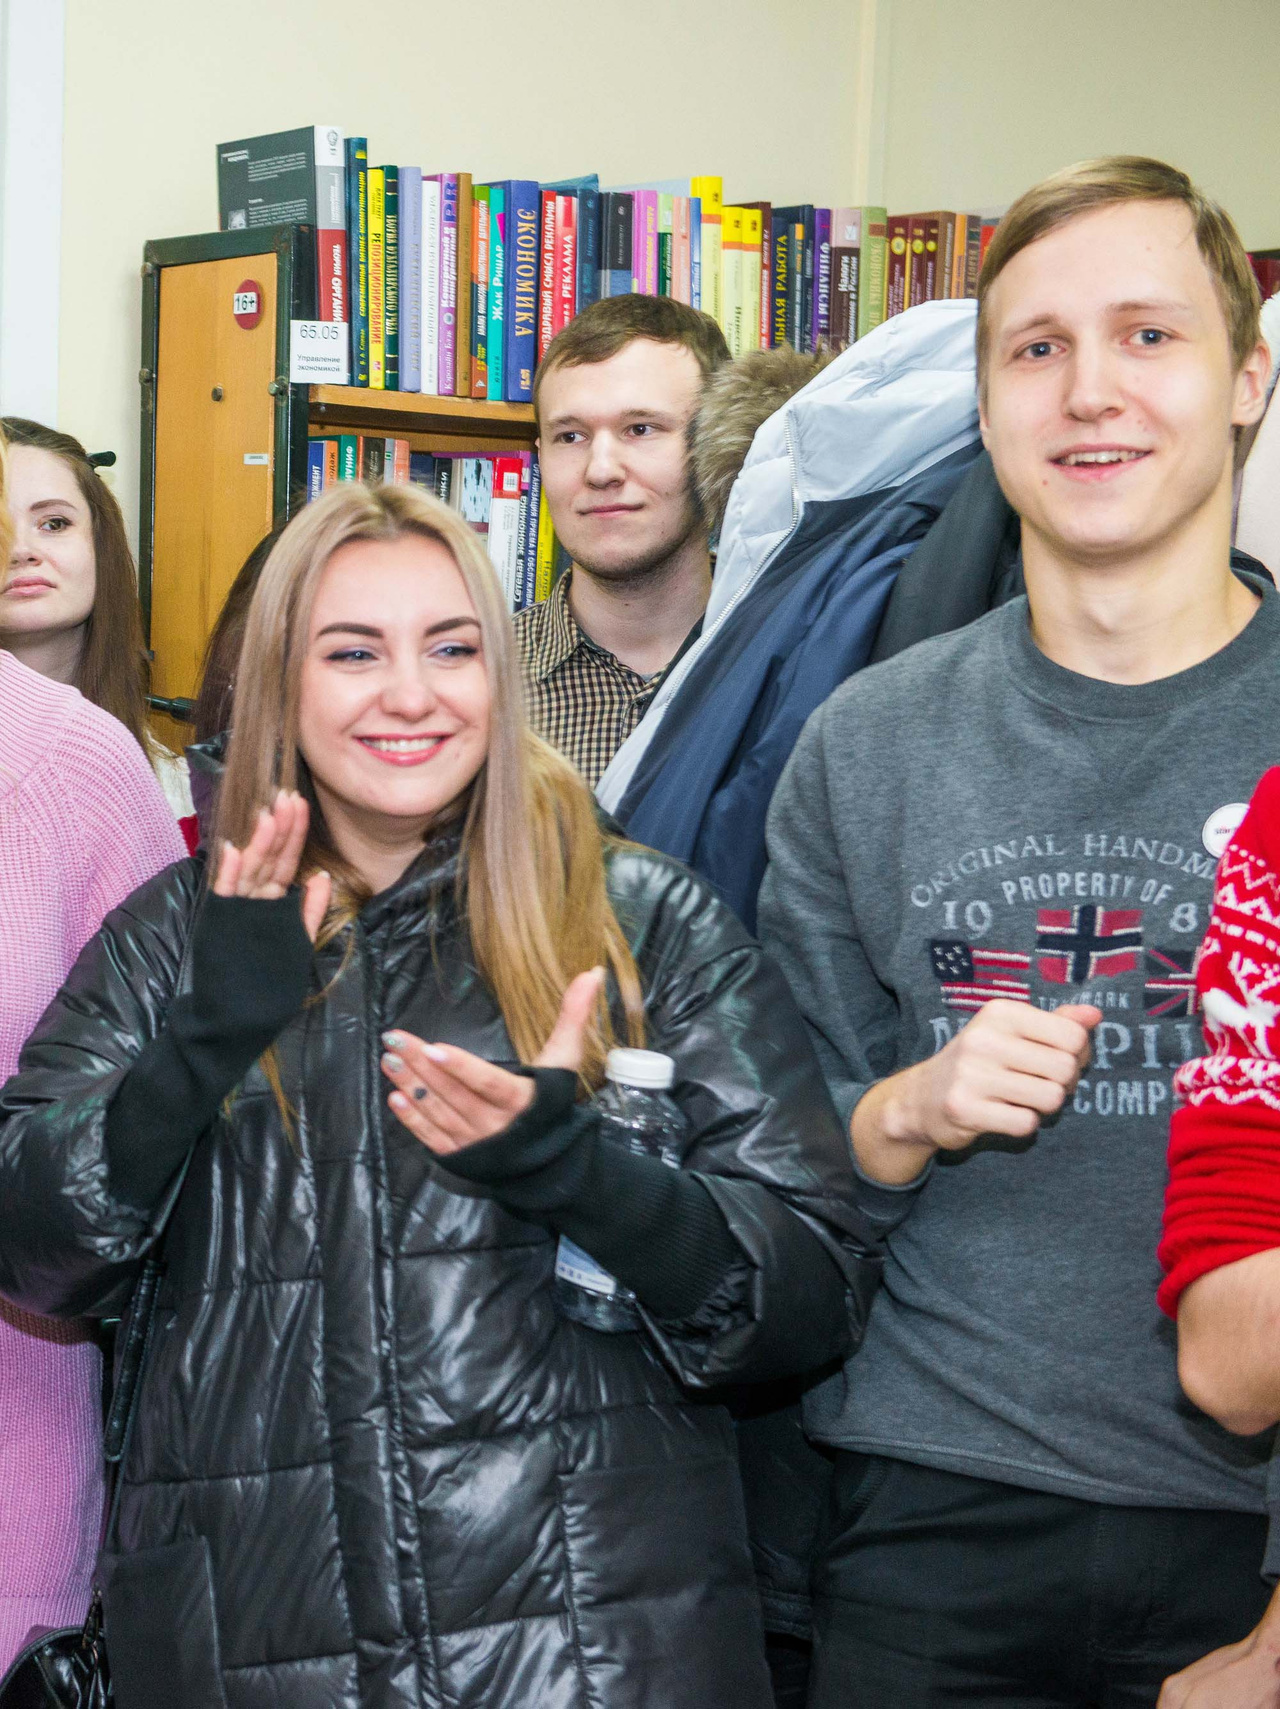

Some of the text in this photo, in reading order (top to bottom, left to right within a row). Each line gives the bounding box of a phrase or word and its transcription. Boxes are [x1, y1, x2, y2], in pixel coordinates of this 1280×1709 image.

[386, 215, 398, 244] ТЕОРИЯ
[543, 201, 555, 250] РЕКЛАМЫ
[386, 246, 398, 311] БУХГАЛТЕРСКОГО
[516, 209, 535, 337] ЭКОНОМИКА
[542, 253, 554, 288] СМЫСЛ
[561, 234, 573, 299] РЕКЛАМА
[775, 235, 787, 292] РАБОТА
[818, 242, 829, 315] ФИНАНСЫ
[837, 255, 849, 292] Налоги
[848, 255, 858, 292] России
[331, 244, 344, 322] ТЕОРИЯ ОРГАНИ
[358, 264, 367, 317] СОВРЕМЕННЫЕ
[235, 294, 255, 311] 16+
[300, 325, 339, 340] 65.05
[297, 354, 341, 363] Управление
[297, 364, 340, 372] экономикой
[529, 463, 540, 516] ОРГАНИЗАЦИЯ
[513, 496, 528, 603] Сетевая экономика
[528, 518, 537, 548] ПРИЕМА
[911, 834, 1065, 908] ORIGINAL
[1001, 871, 1174, 906] PROPERTY OF
[1169, 902, 1212, 934] 8
[1072, 1079, 1172, 1117] COMP
